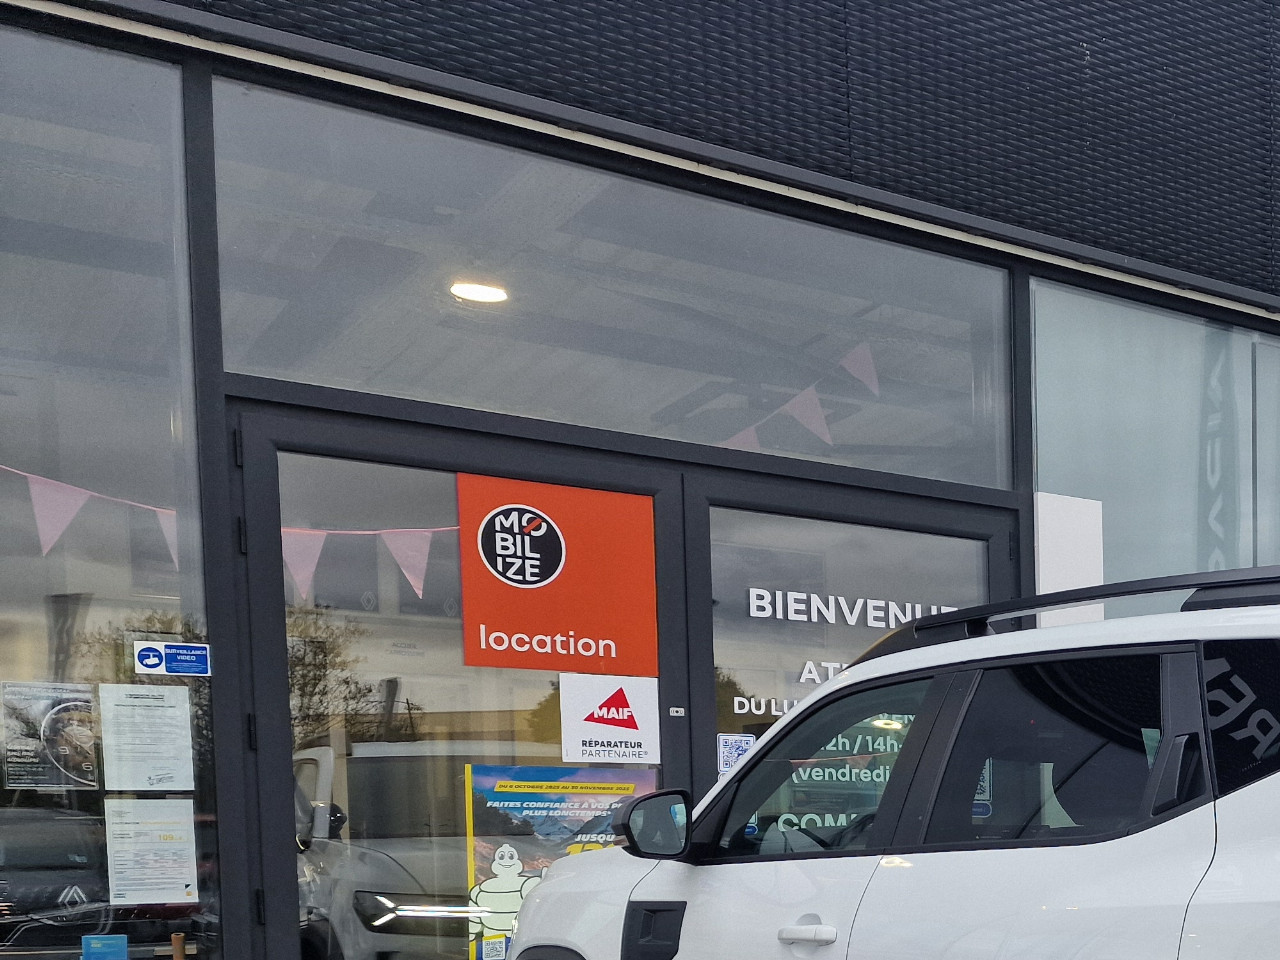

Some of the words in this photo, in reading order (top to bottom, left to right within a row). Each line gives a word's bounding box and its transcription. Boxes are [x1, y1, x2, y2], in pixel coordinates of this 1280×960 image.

[495, 532, 541, 559] BIL
[496, 556, 541, 581] IZE
[750, 588, 959, 628] BIENVEN
[479, 624, 617, 658] location
[800, 661, 849, 684] AT
[593, 706, 633, 719] MAIF
[733, 696, 766, 715] DU
[581, 738, 643, 749] RÉPARATEUR
[522, 801, 581, 809] CONFIANCE
[777, 813, 858, 832] COM
